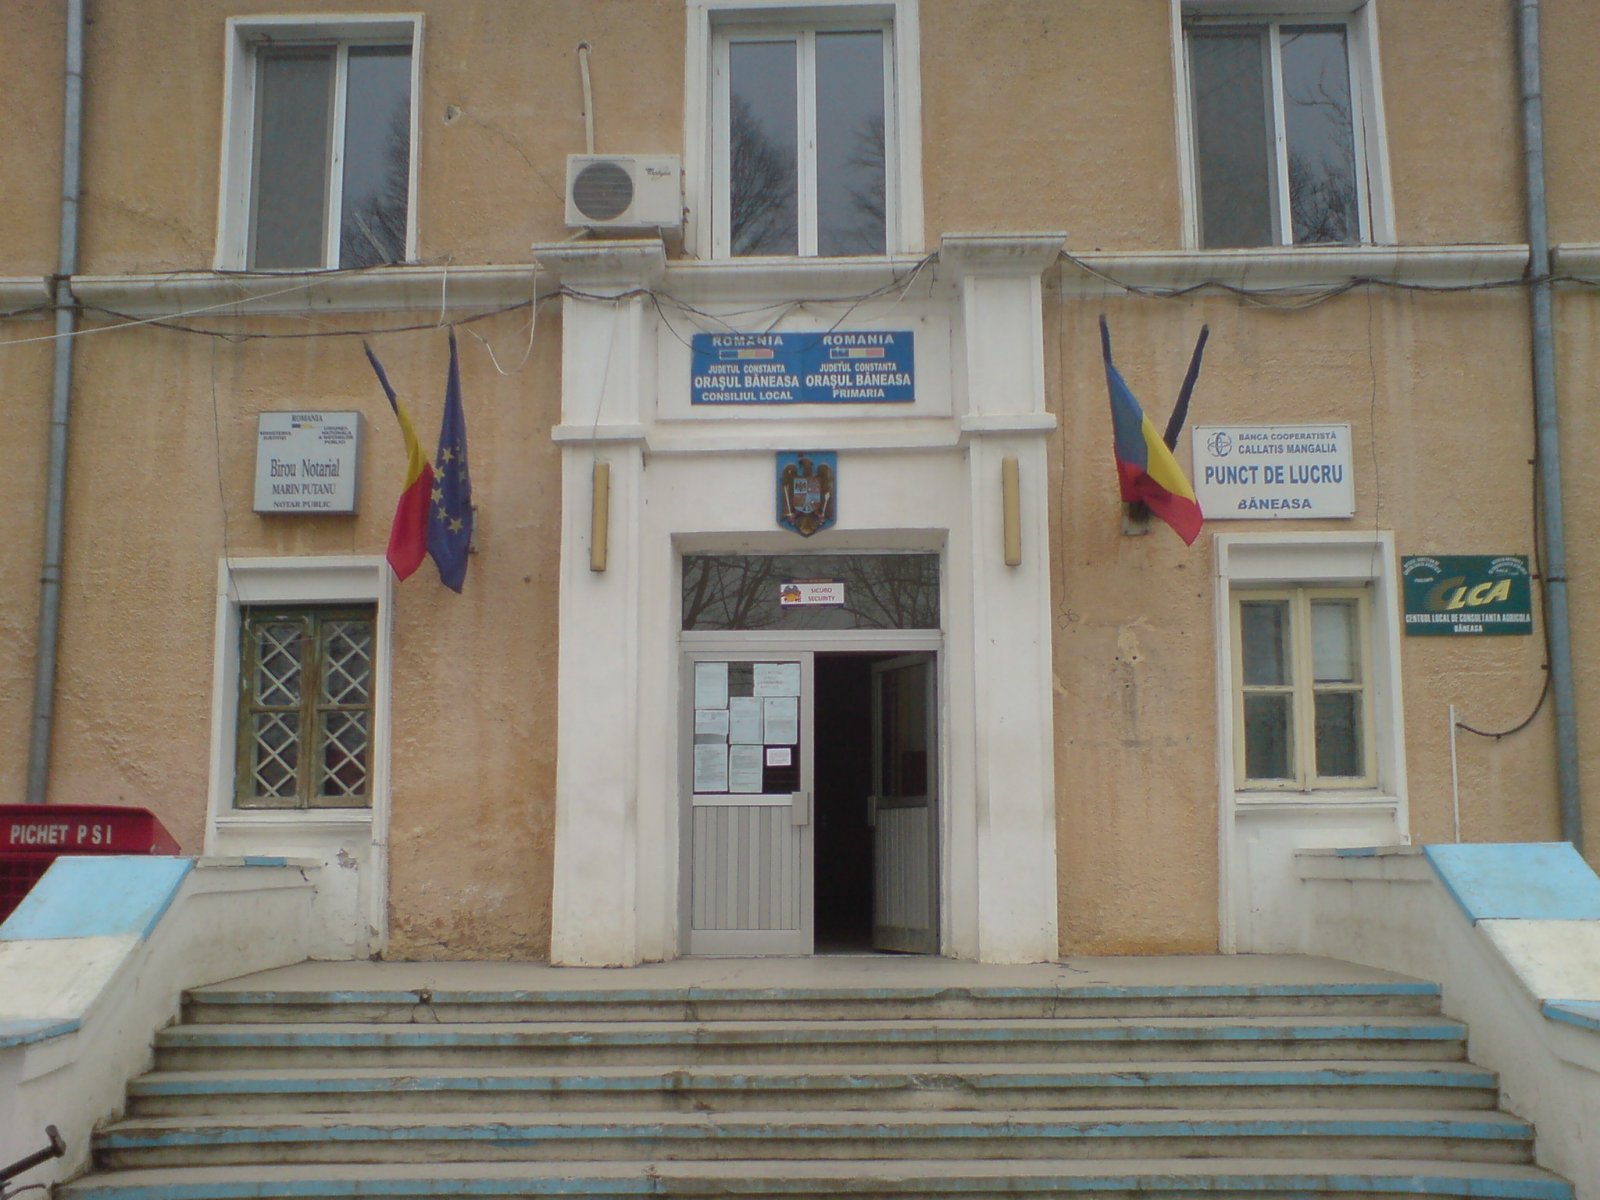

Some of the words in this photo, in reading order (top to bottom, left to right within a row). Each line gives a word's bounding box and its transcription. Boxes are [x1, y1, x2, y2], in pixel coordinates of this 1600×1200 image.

[713, 336, 783, 346] ROMANIA
[824, 335, 894, 345] ROMANIA
[745, 374, 799, 387] BĂNEASA
[856, 372, 911, 386] BĂNEASA
[702, 392, 756, 400] CONSILIUL
[760, 391, 793, 400] LOCAL
[1239, 445, 1283, 454] CALLATIS
[1287, 444, 1336, 453] MANGALIA
[271, 459, 296, 477] Birou
[302, 459, 340, 477] Notarial
[1206, 466, 1258, 484] PUNCT
[1264, 466, 1284, 484] DE
[1290, 465, 1342, 484] LUCRU
[272, 484, 300, 494] MARIN
[1238, 496, 1312, 510] BĂNEASA
[10, 825, 69, 844] PICHET
